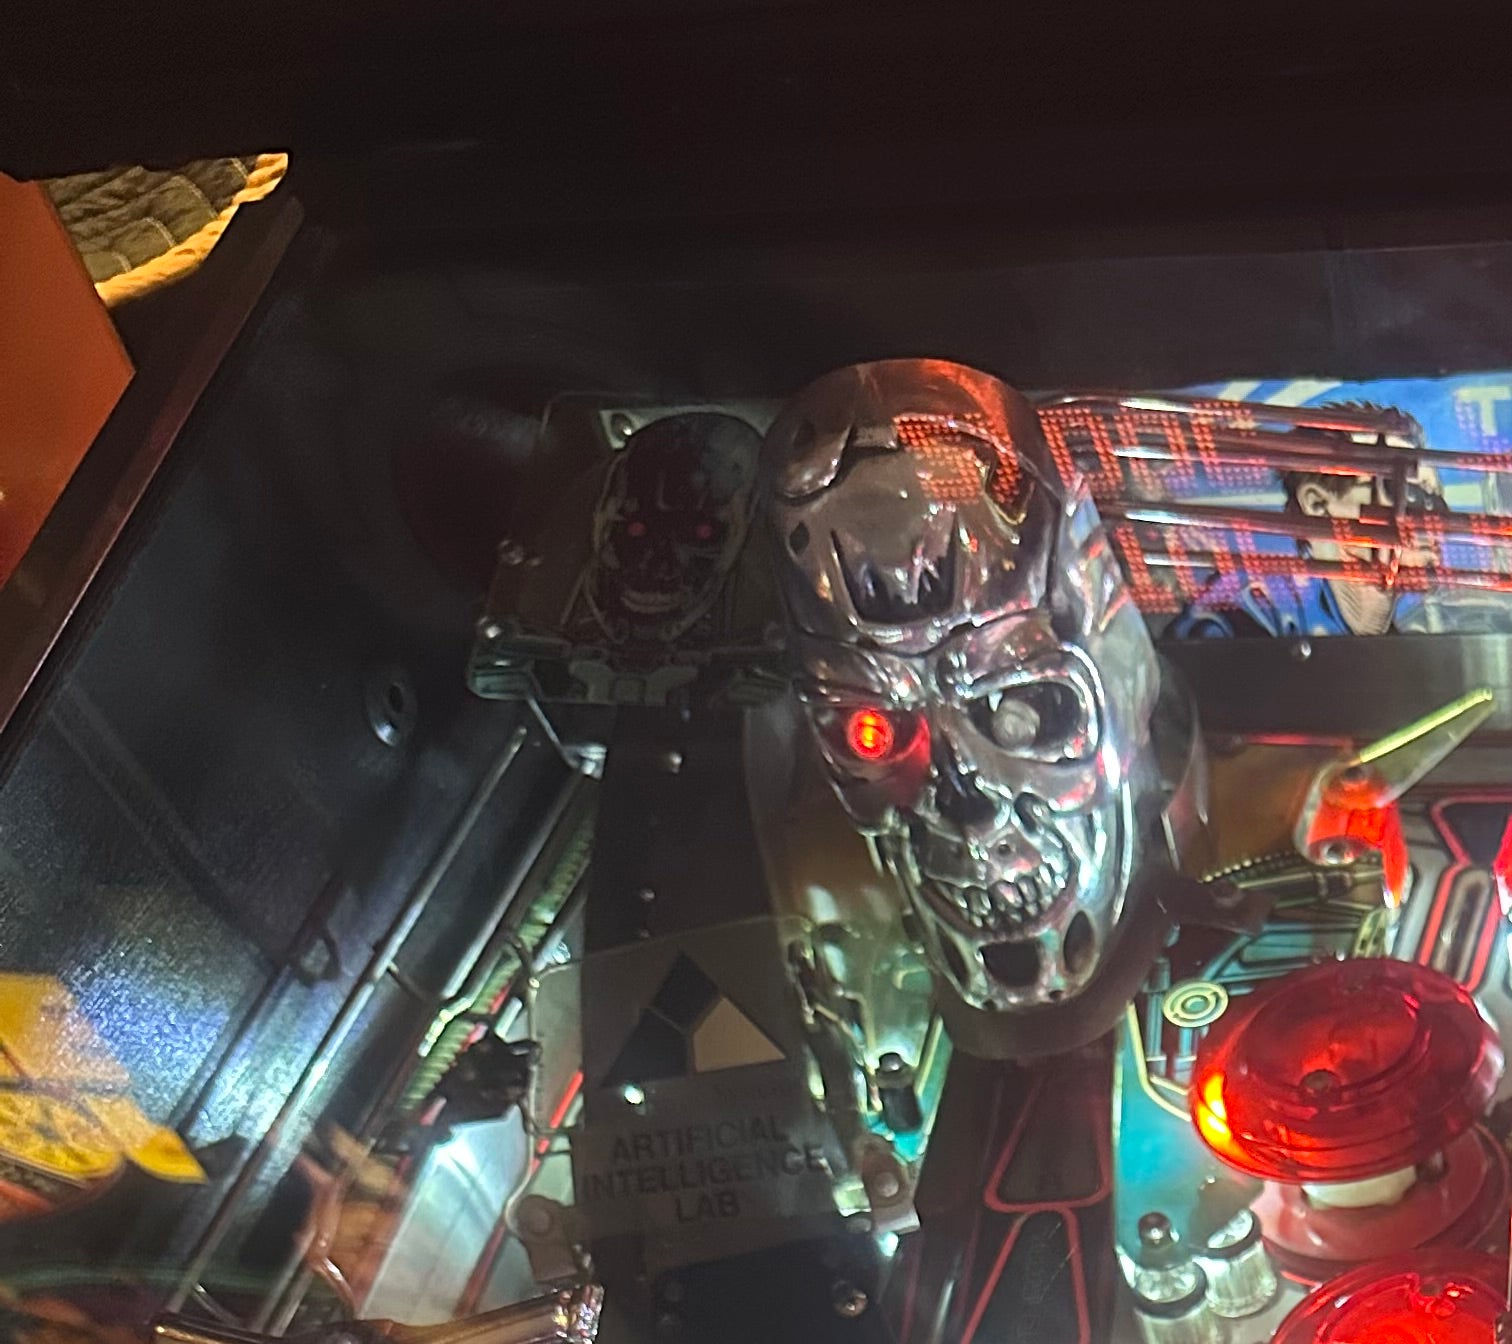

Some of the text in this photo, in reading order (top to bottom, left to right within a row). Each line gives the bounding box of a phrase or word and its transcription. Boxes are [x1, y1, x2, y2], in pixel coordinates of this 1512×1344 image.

[611, 1115, 790, 1165] ARTIFICIAL
[581, 1143, 826, 1200] INTELLIGENCE
[674, 1193, 740, 1224] LAB
